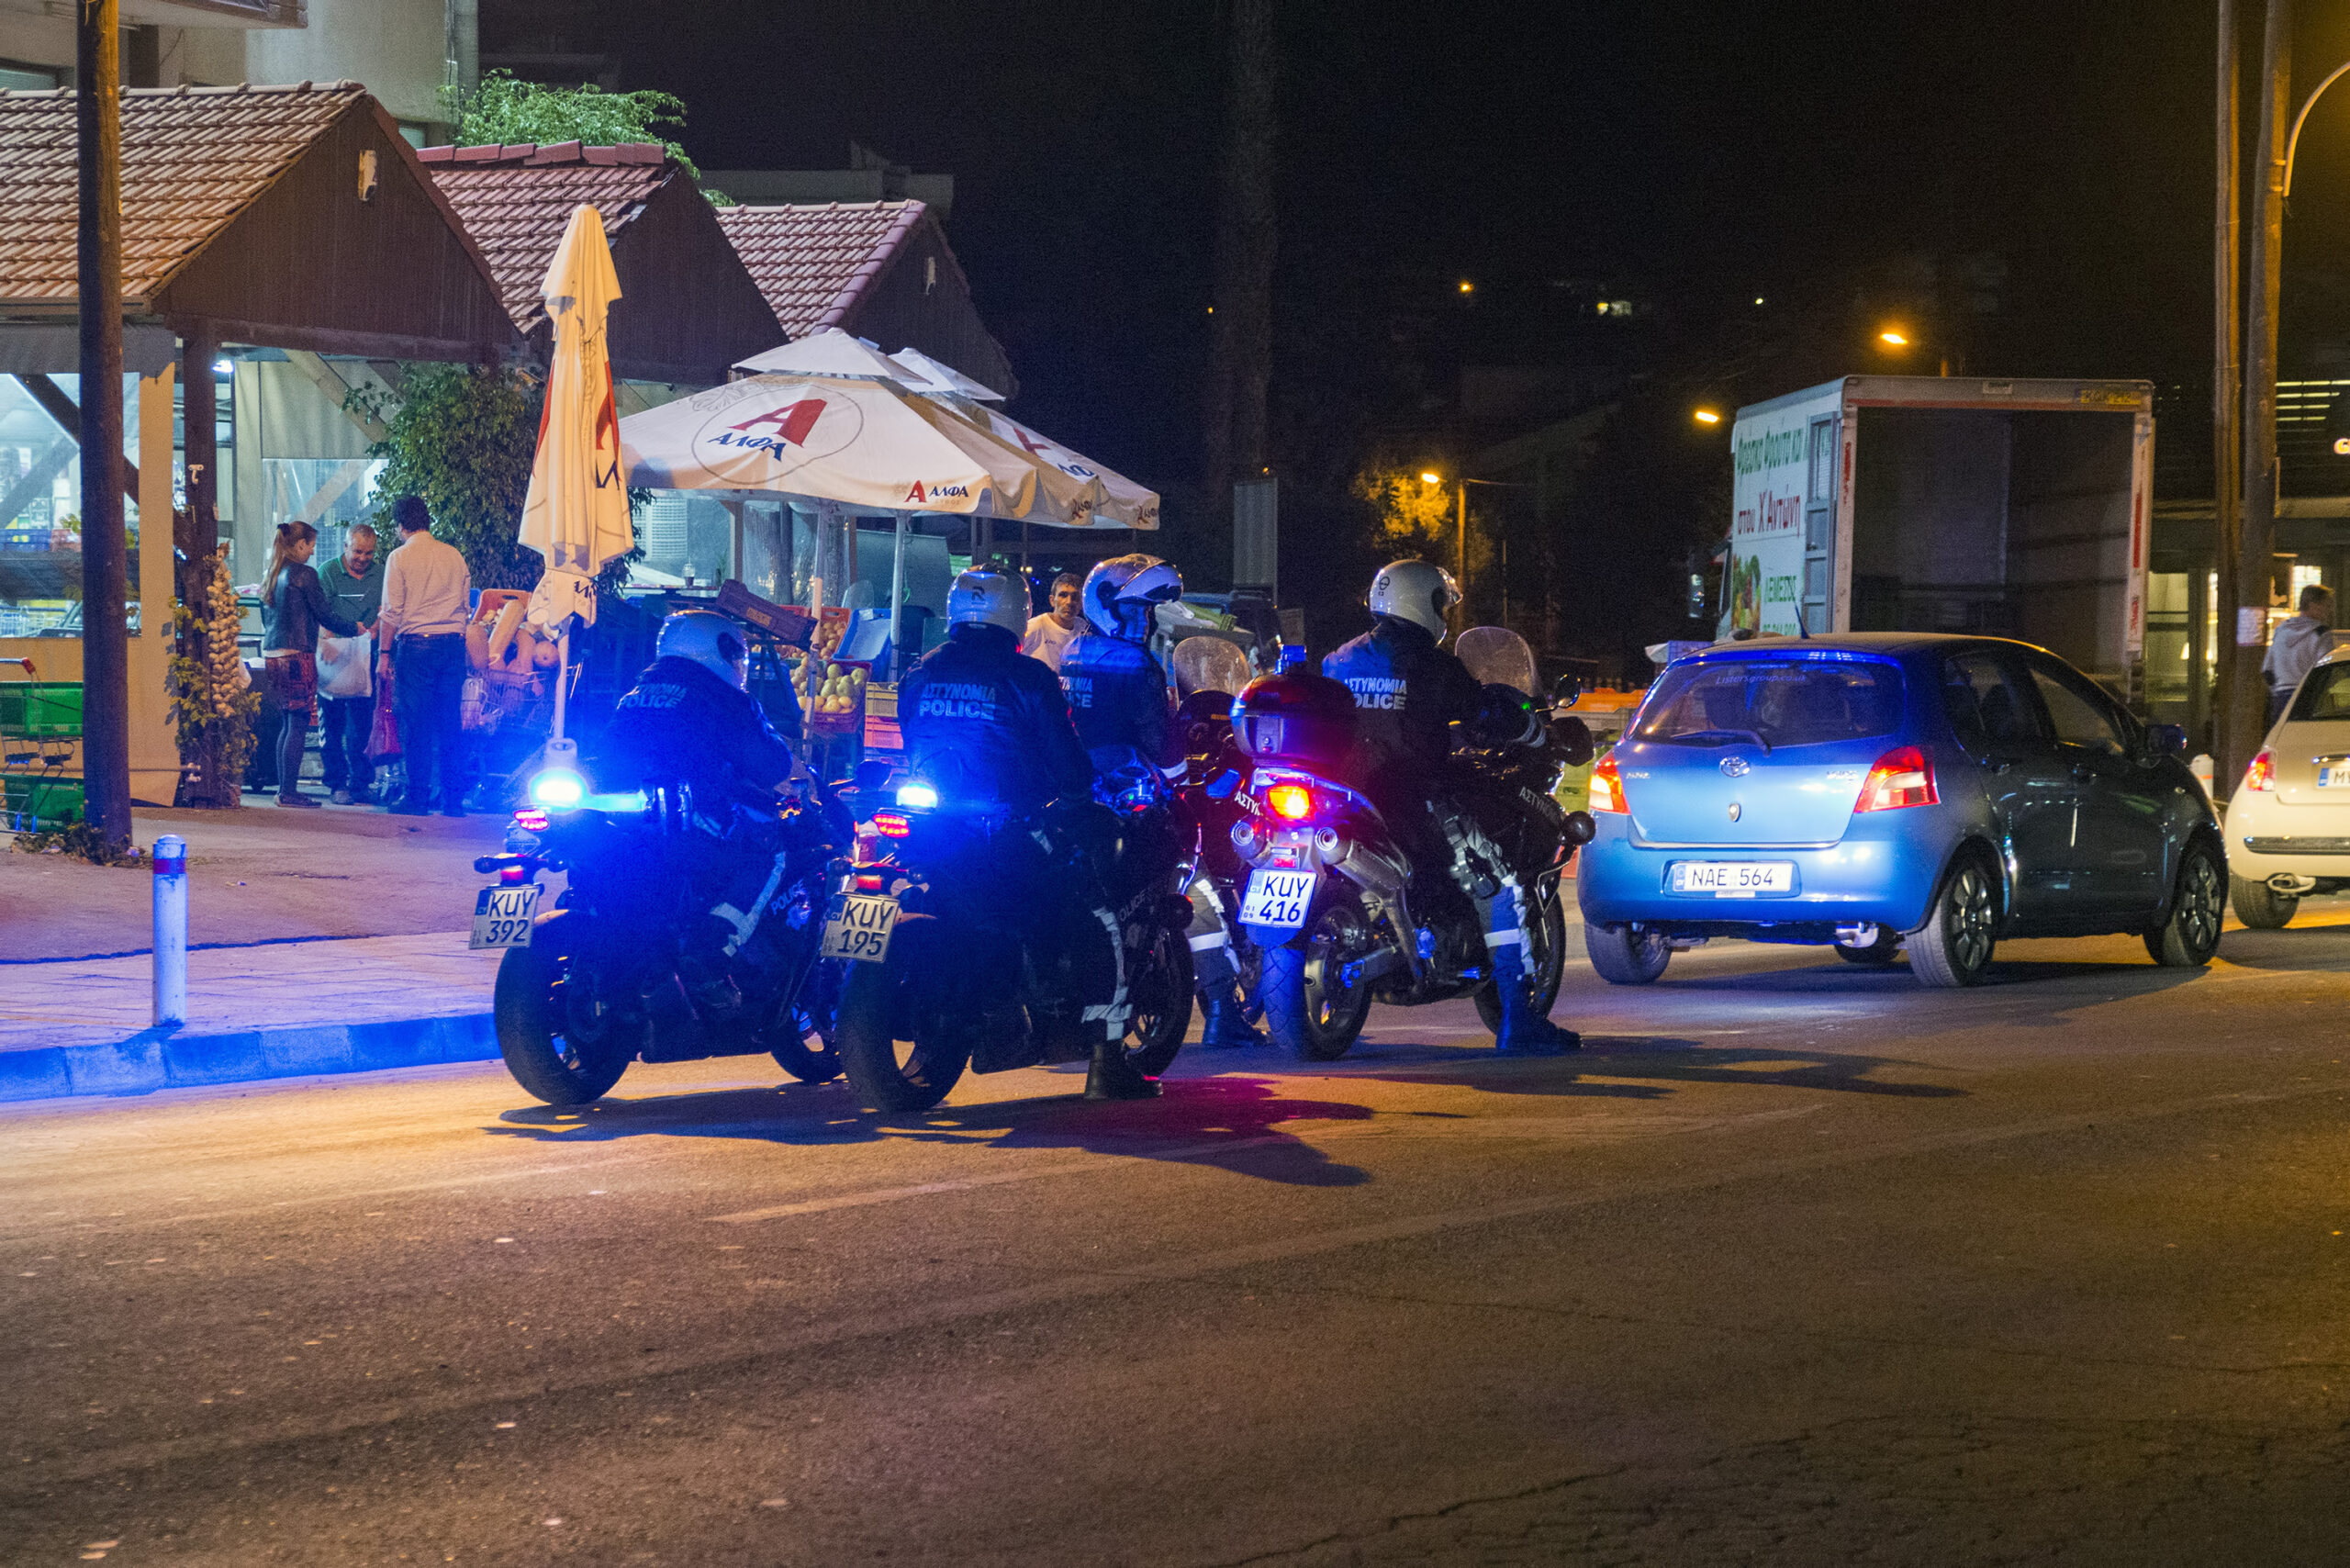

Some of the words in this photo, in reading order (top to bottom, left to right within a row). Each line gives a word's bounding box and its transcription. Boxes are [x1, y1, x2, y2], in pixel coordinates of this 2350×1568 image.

[706, 432, 787, 463] ΑΛΦΑ
[929, 486, 969, 498] ΑΛΦΑ
[920, 683, 996, 703] ΑΣΤΥΝΟΜΙΑ
[919, 700, 996, 721] POLICE
[2333, 770, 2350, 784] M
[1263, 875, 1309, 898] KUY
[1692, 868, 1728, 886] NAE
[1740, 868, 1774, 886] 564
[489, 890, 535, 917] KUY
[843, 901, 895, 929] KUY
[1259, 900, 1301, 923] 416
[486, 919, 530, 944] 392
[837, 929, 887, 956] 195
